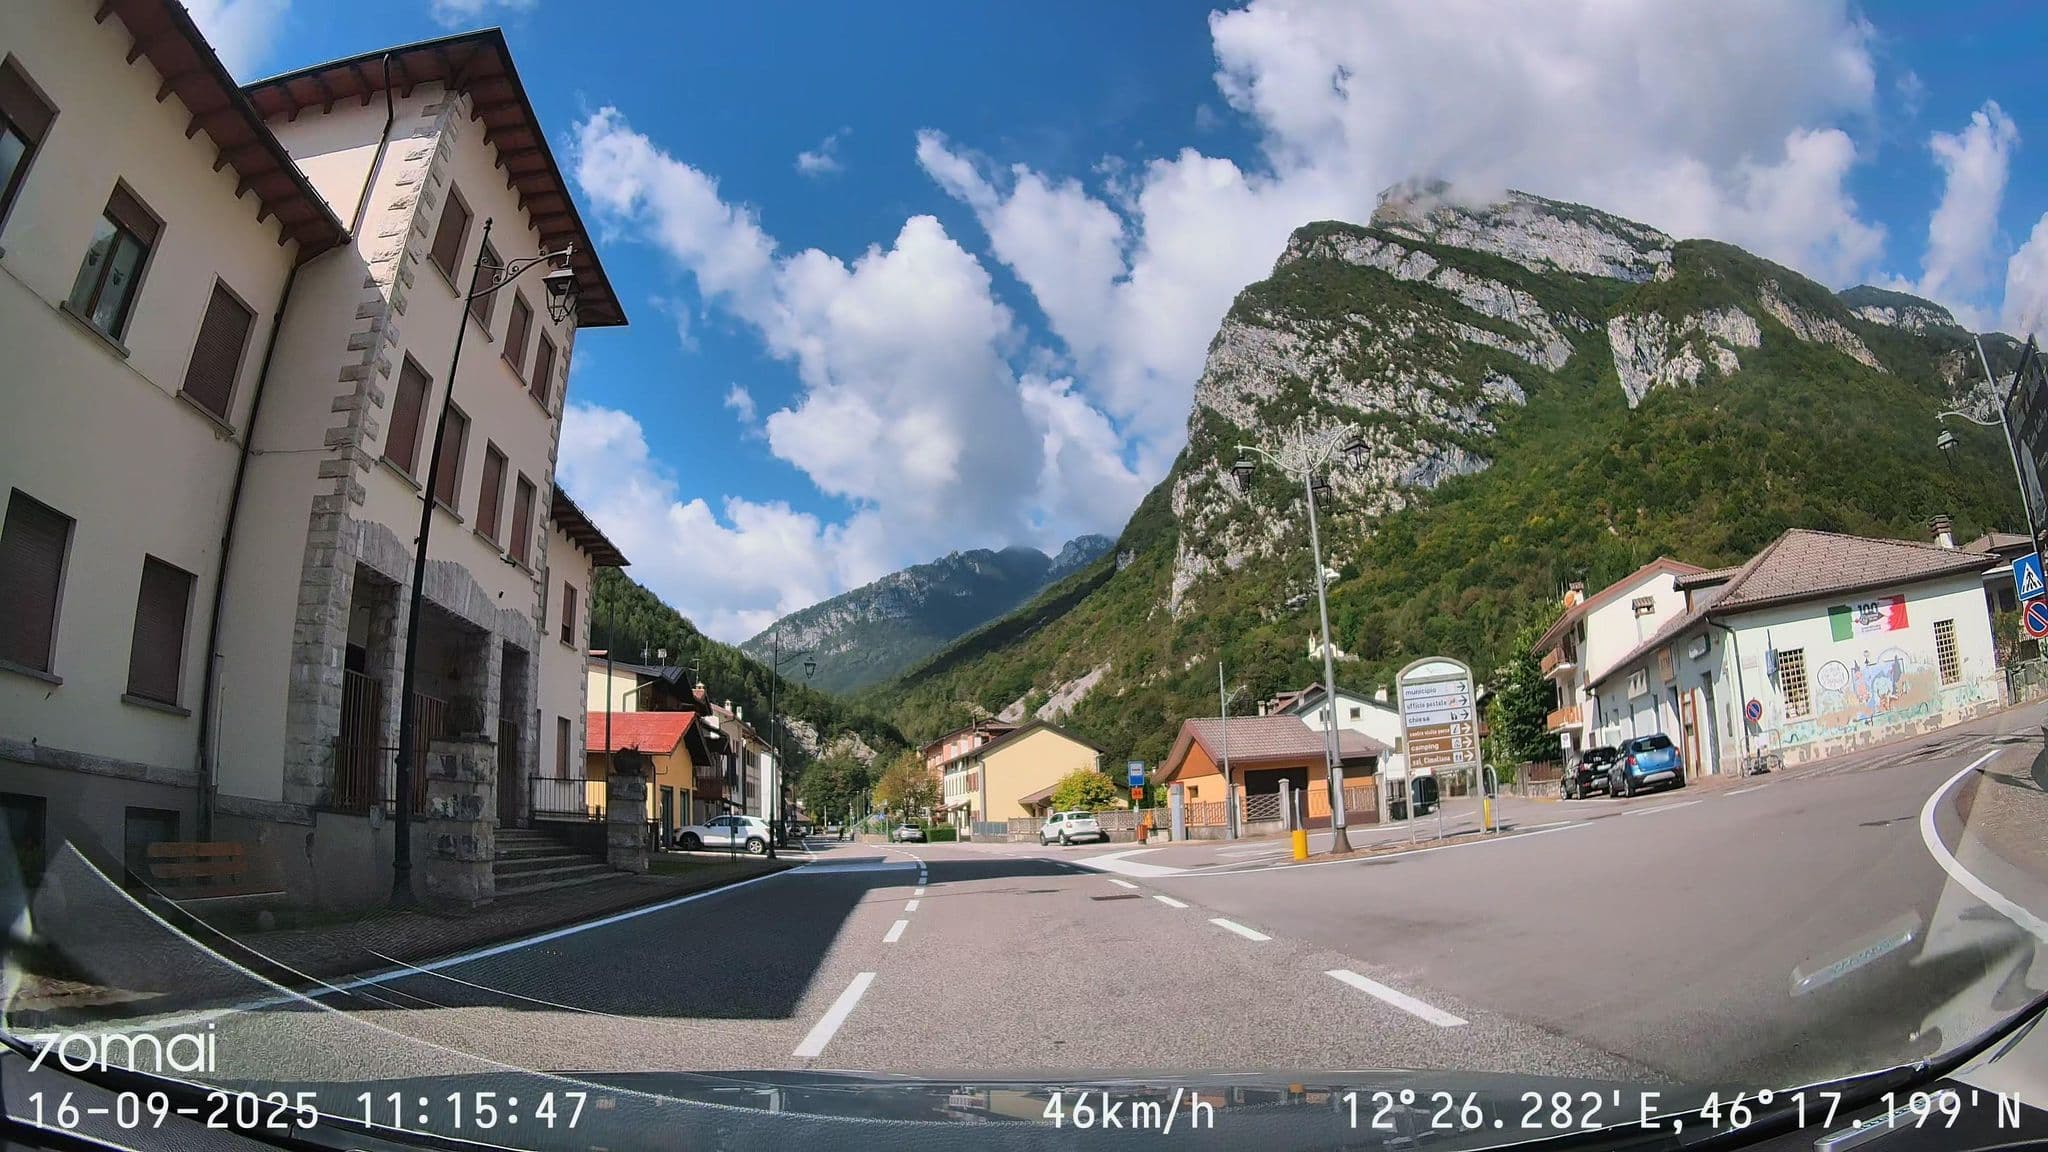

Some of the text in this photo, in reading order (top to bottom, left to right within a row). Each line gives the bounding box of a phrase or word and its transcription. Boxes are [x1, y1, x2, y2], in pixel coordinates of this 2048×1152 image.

[1405, 688, 1437, 697] municipio
[1406, 702, 1425, 711] ufficio
[1426, 700, 1447, 709] postale
[1408, 716, 1430, 724] chiesa
[1410, 743, 1439, 751] camping
